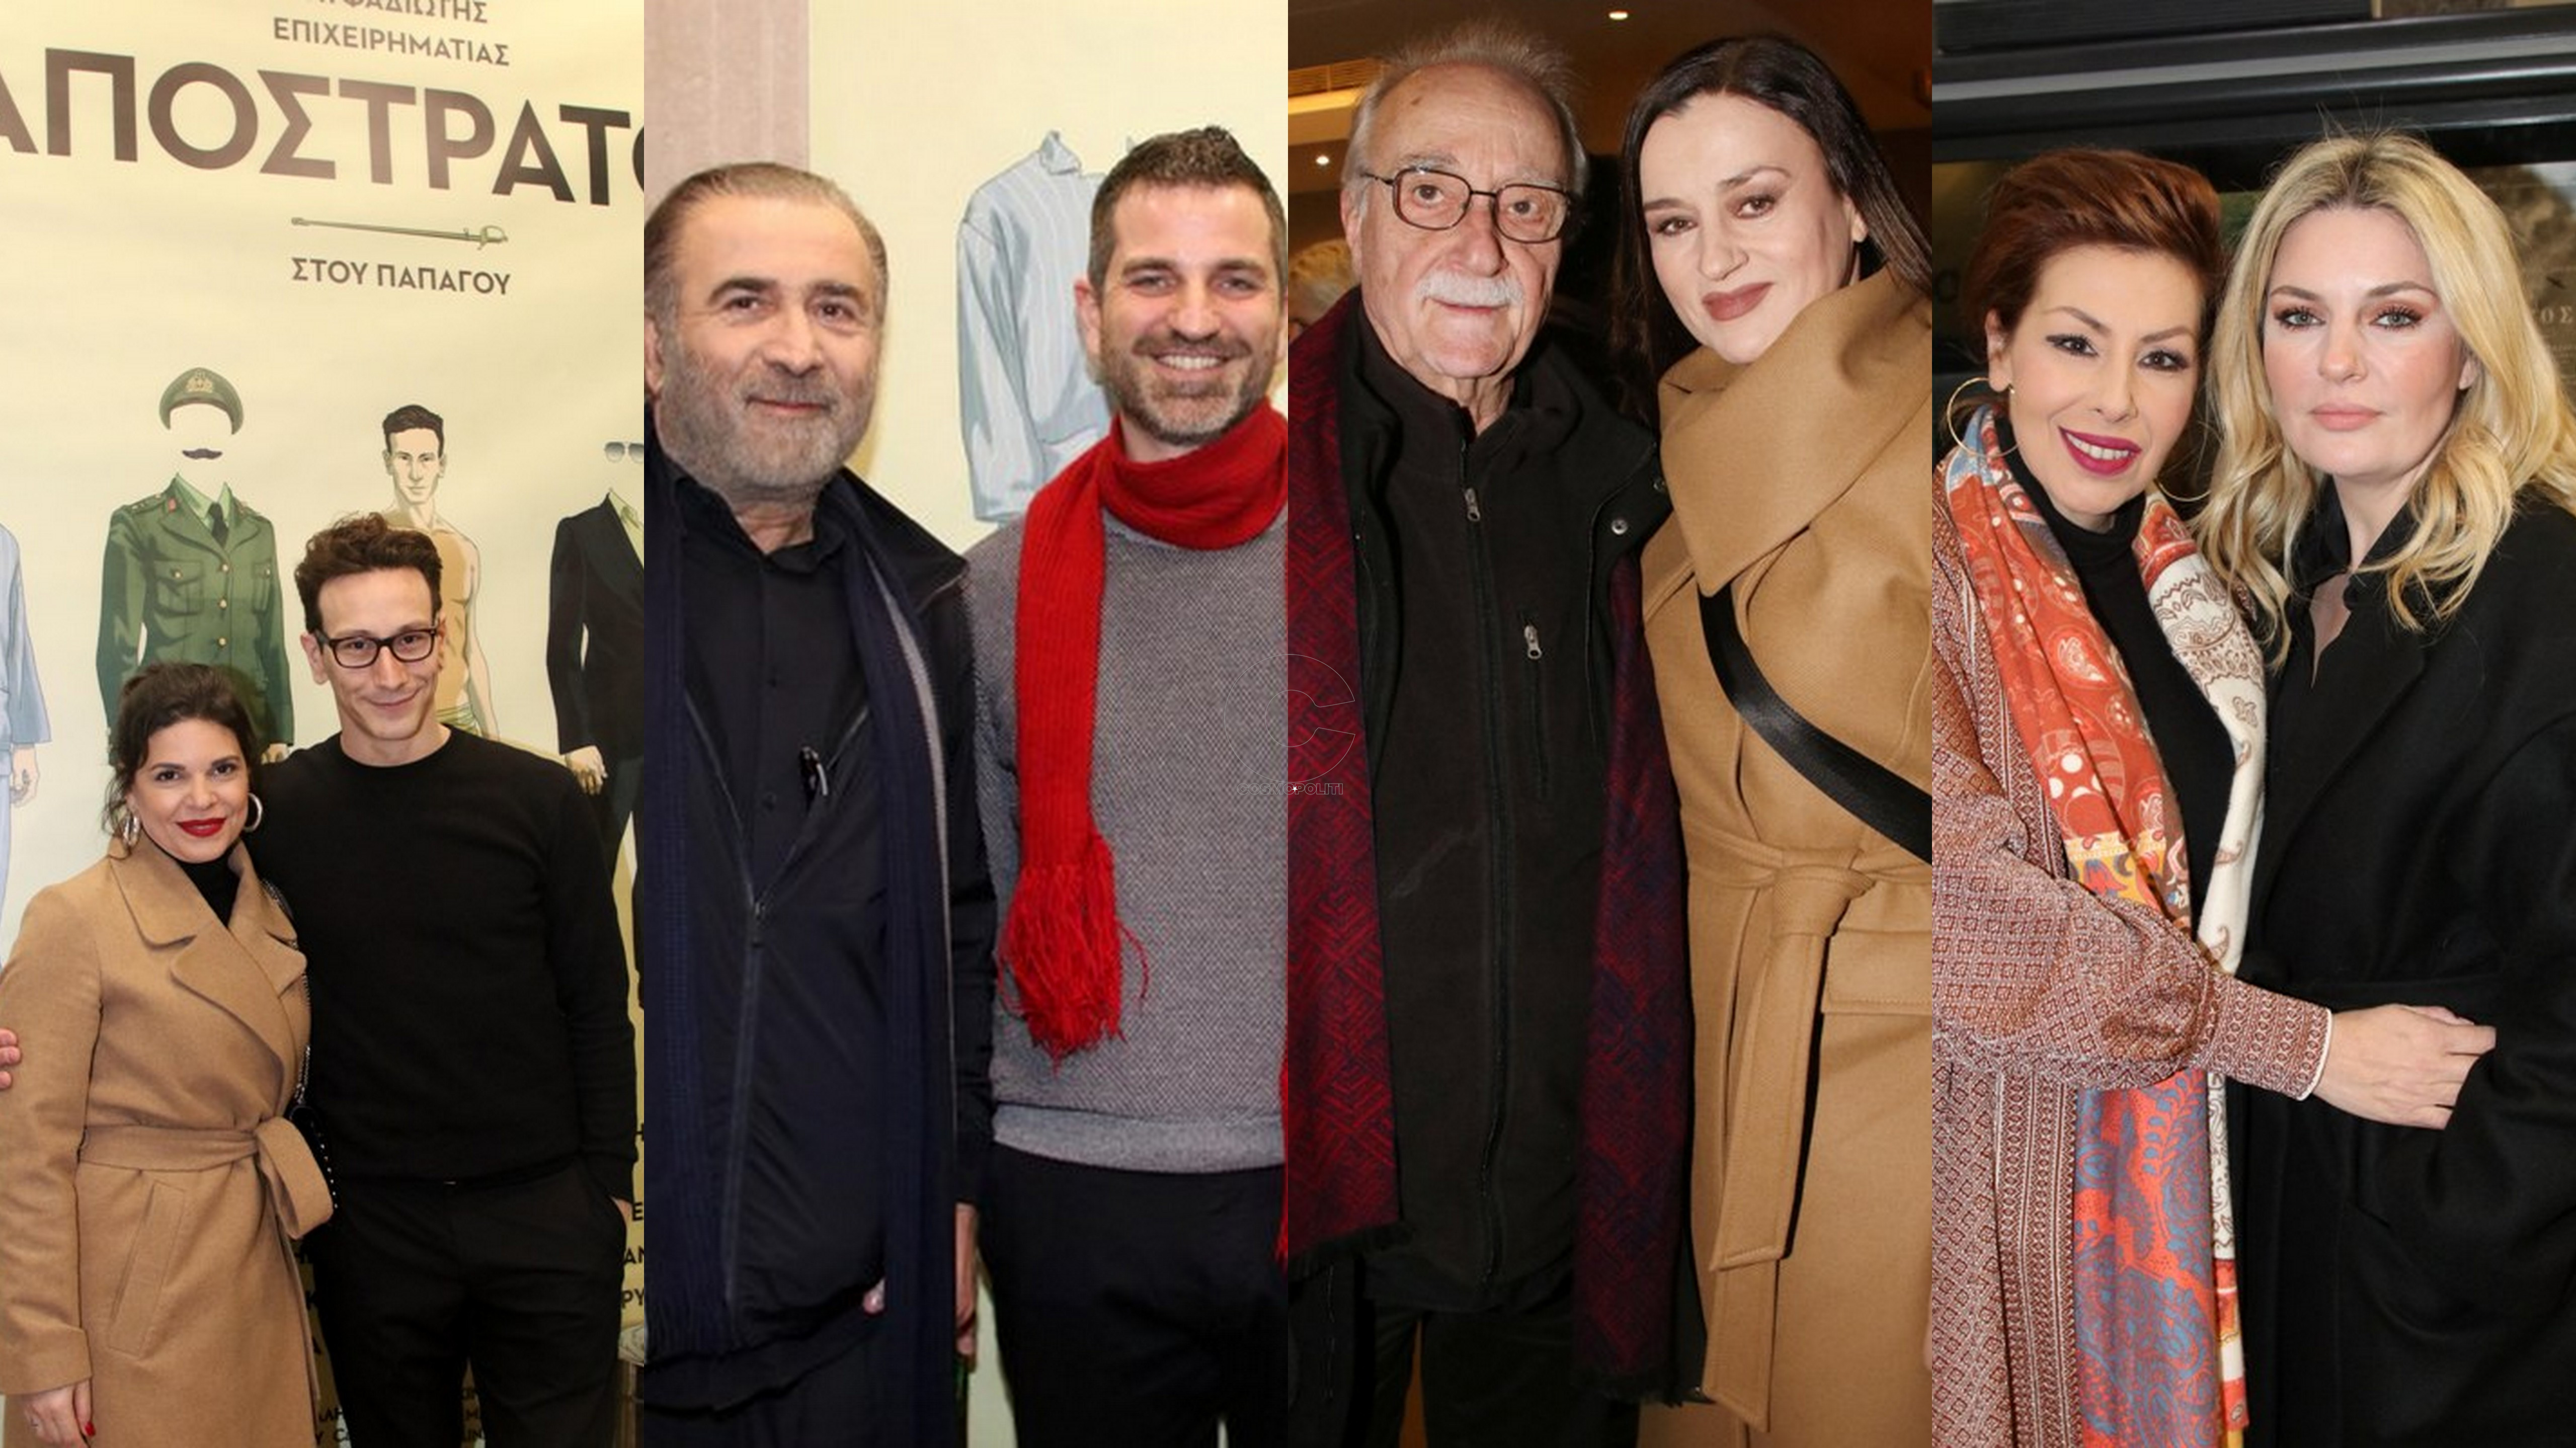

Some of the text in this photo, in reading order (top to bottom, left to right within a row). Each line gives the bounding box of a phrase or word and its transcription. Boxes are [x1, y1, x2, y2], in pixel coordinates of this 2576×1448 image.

[274, 17, 510, 66] ΕΠΙΧΕΙΡΗΜΑΤΙΑΣ
[0, 47, 644, 206] ΠΟΣΤΡΑΤ
[291, 257, 511, 295] ΣΤΟΥ ΠΑΠΑΓΟΥ
